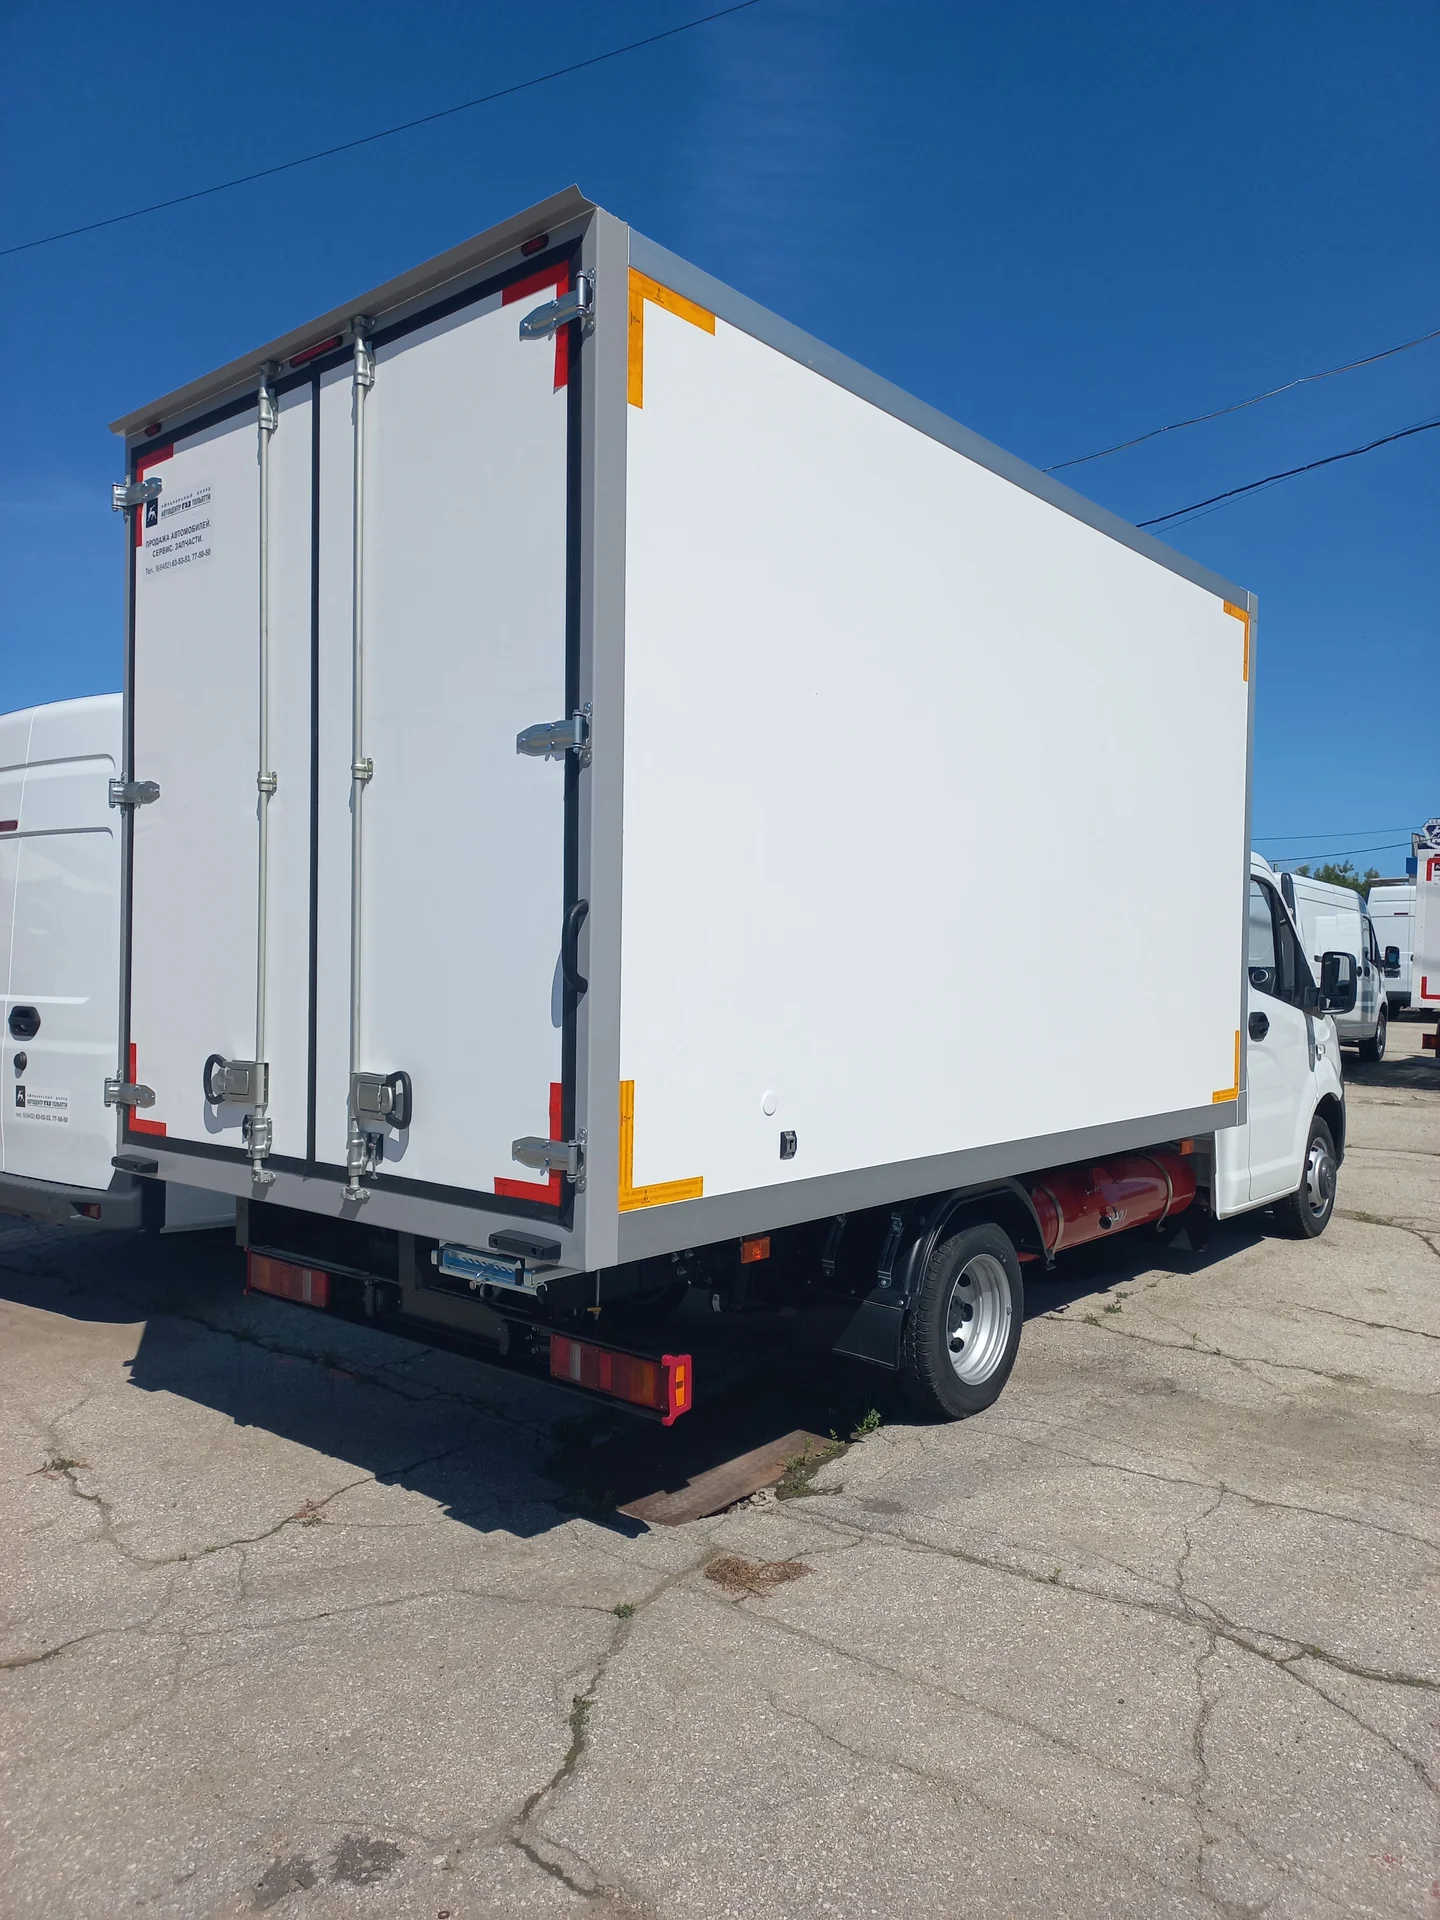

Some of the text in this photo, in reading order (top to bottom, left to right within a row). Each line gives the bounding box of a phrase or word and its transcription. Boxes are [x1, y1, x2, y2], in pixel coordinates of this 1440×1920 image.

[145, 518, 211, 548] ПРОДАЖА АВТОМОБИЛЕЙ.
[152, 535, 203, 558] СЕРВИС. ЗАПЧАСТИ.
